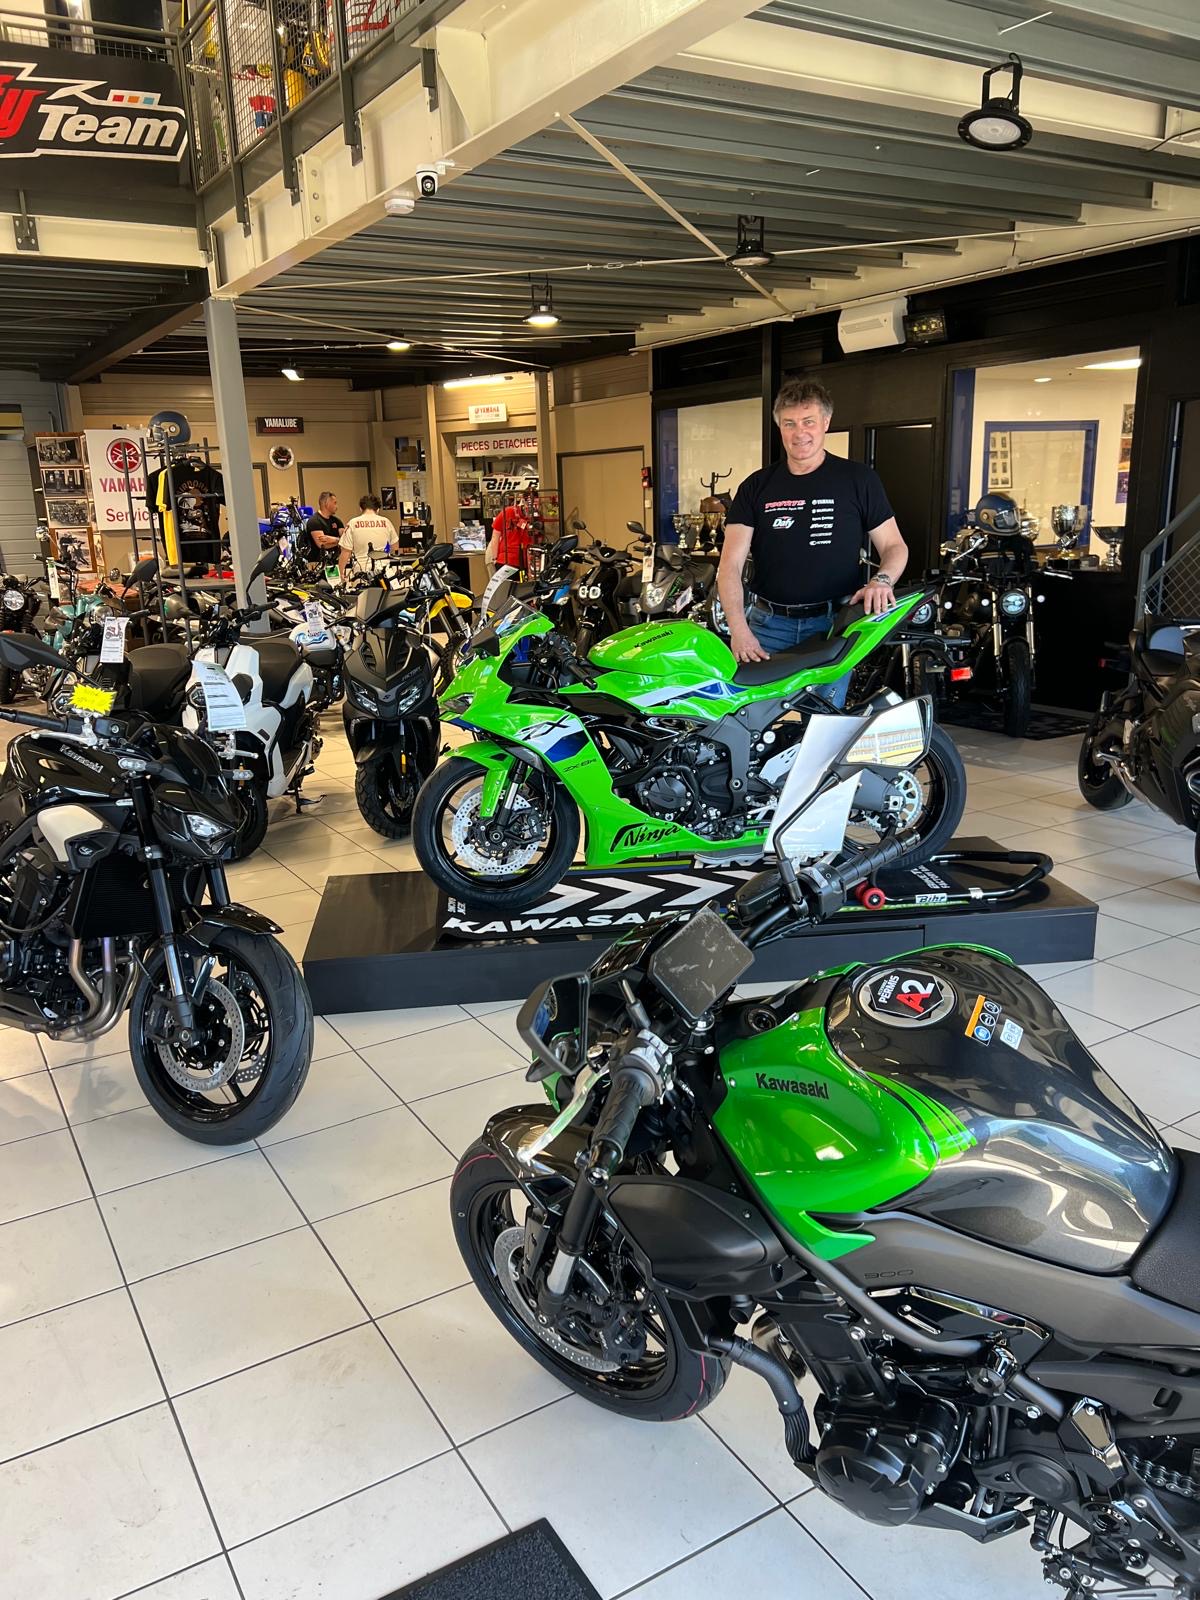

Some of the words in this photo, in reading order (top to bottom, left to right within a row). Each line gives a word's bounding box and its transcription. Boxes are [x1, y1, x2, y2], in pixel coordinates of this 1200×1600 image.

[38, 104, 179, 148] Team
[264, 418, 298, 428] YAMALUBE
[461, 441, 490, 451] PIECES
[482, 478, 521, 490] Bihr
[354, 520, 387, 529] JORDAN
[633, 629, 674, 648] Kawasaki
[60, 744, 104, 774] Kawasaki
[612, 823, 684, 851] Ninja
[916, 894, 947, 903] Bihr
[878, 974, 900, 1004] PERMIS
[896, 980, 935, 1013] A2
[755, 1072, 829, 1100] Kawasaki
[864, 1269, 914, 1280] 900
